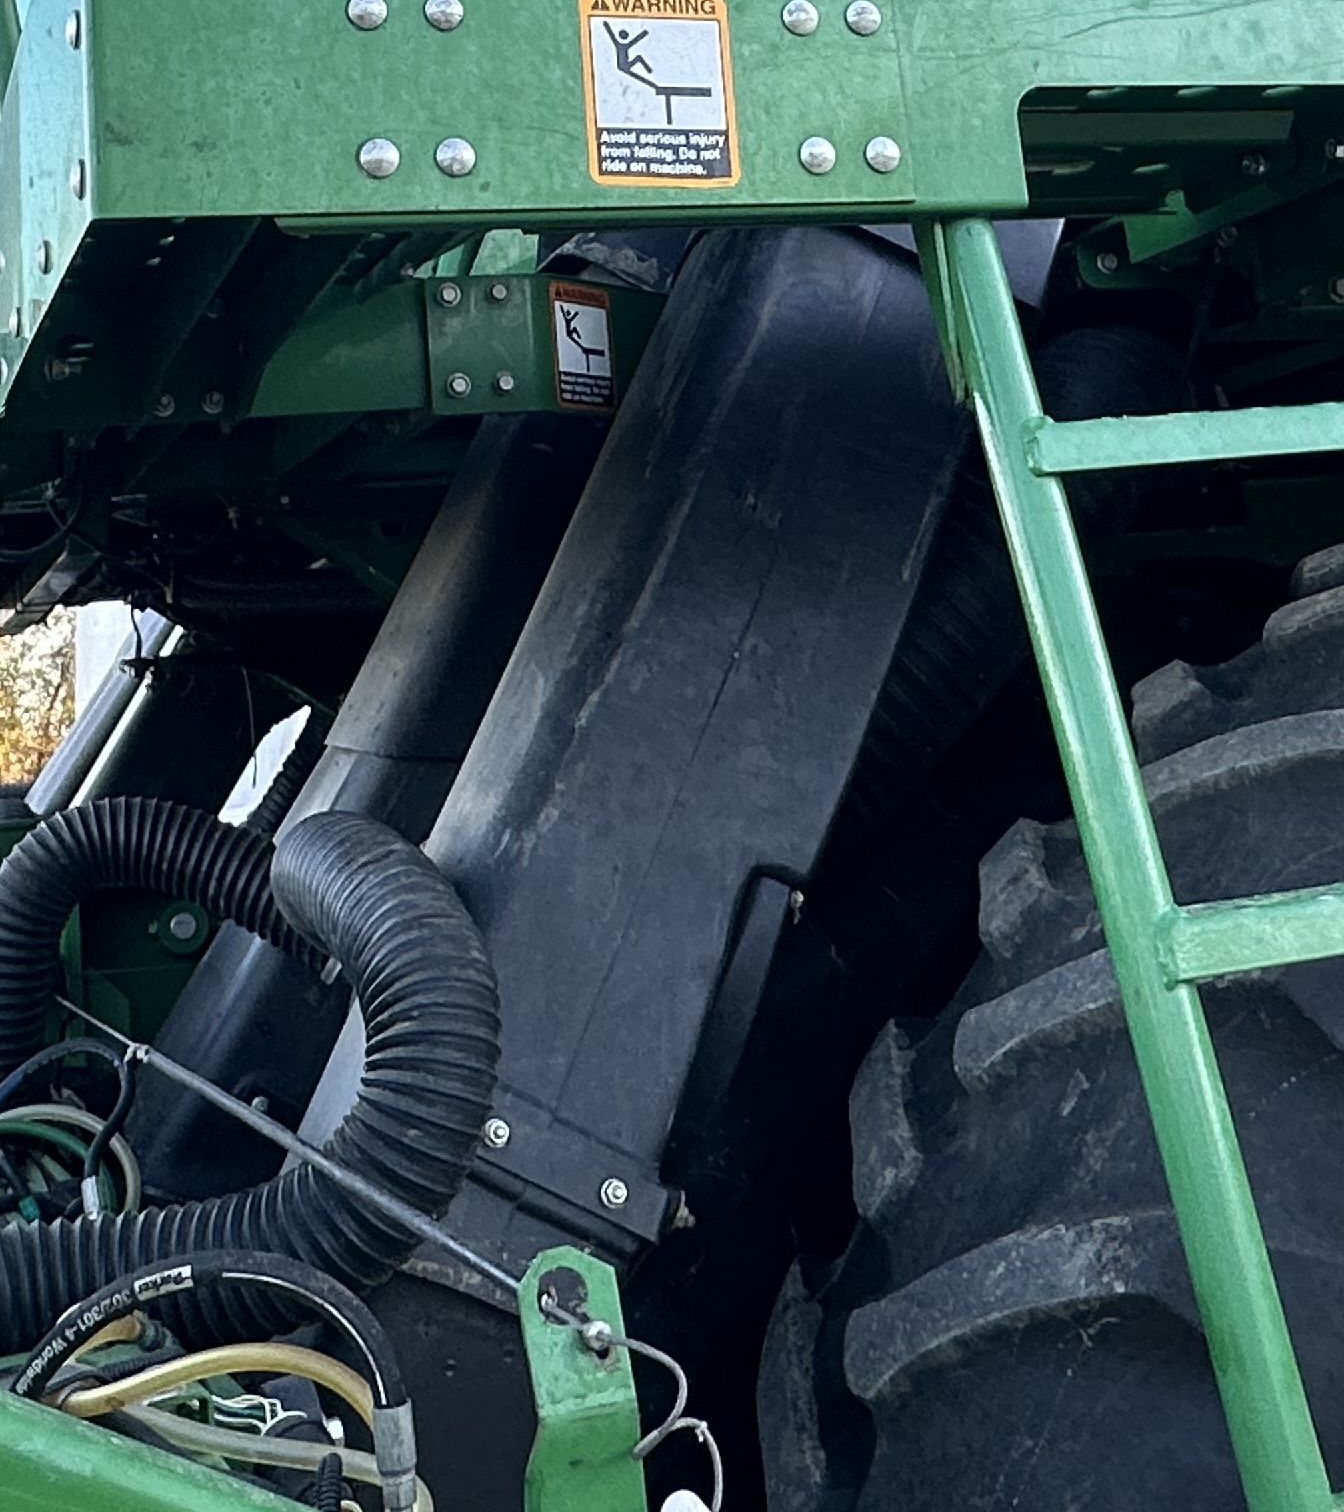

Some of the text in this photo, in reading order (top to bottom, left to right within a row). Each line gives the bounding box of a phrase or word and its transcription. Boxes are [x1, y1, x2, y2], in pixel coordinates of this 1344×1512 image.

[600, 130, 726, 148] Avoid serious injury
[600, 144, 631, 158] from
[678, 147, 698, 160] Do
[699, 148, 722, 161] not
[602, 158, 628, 172] ride
[629, 162, 647, 172] on
